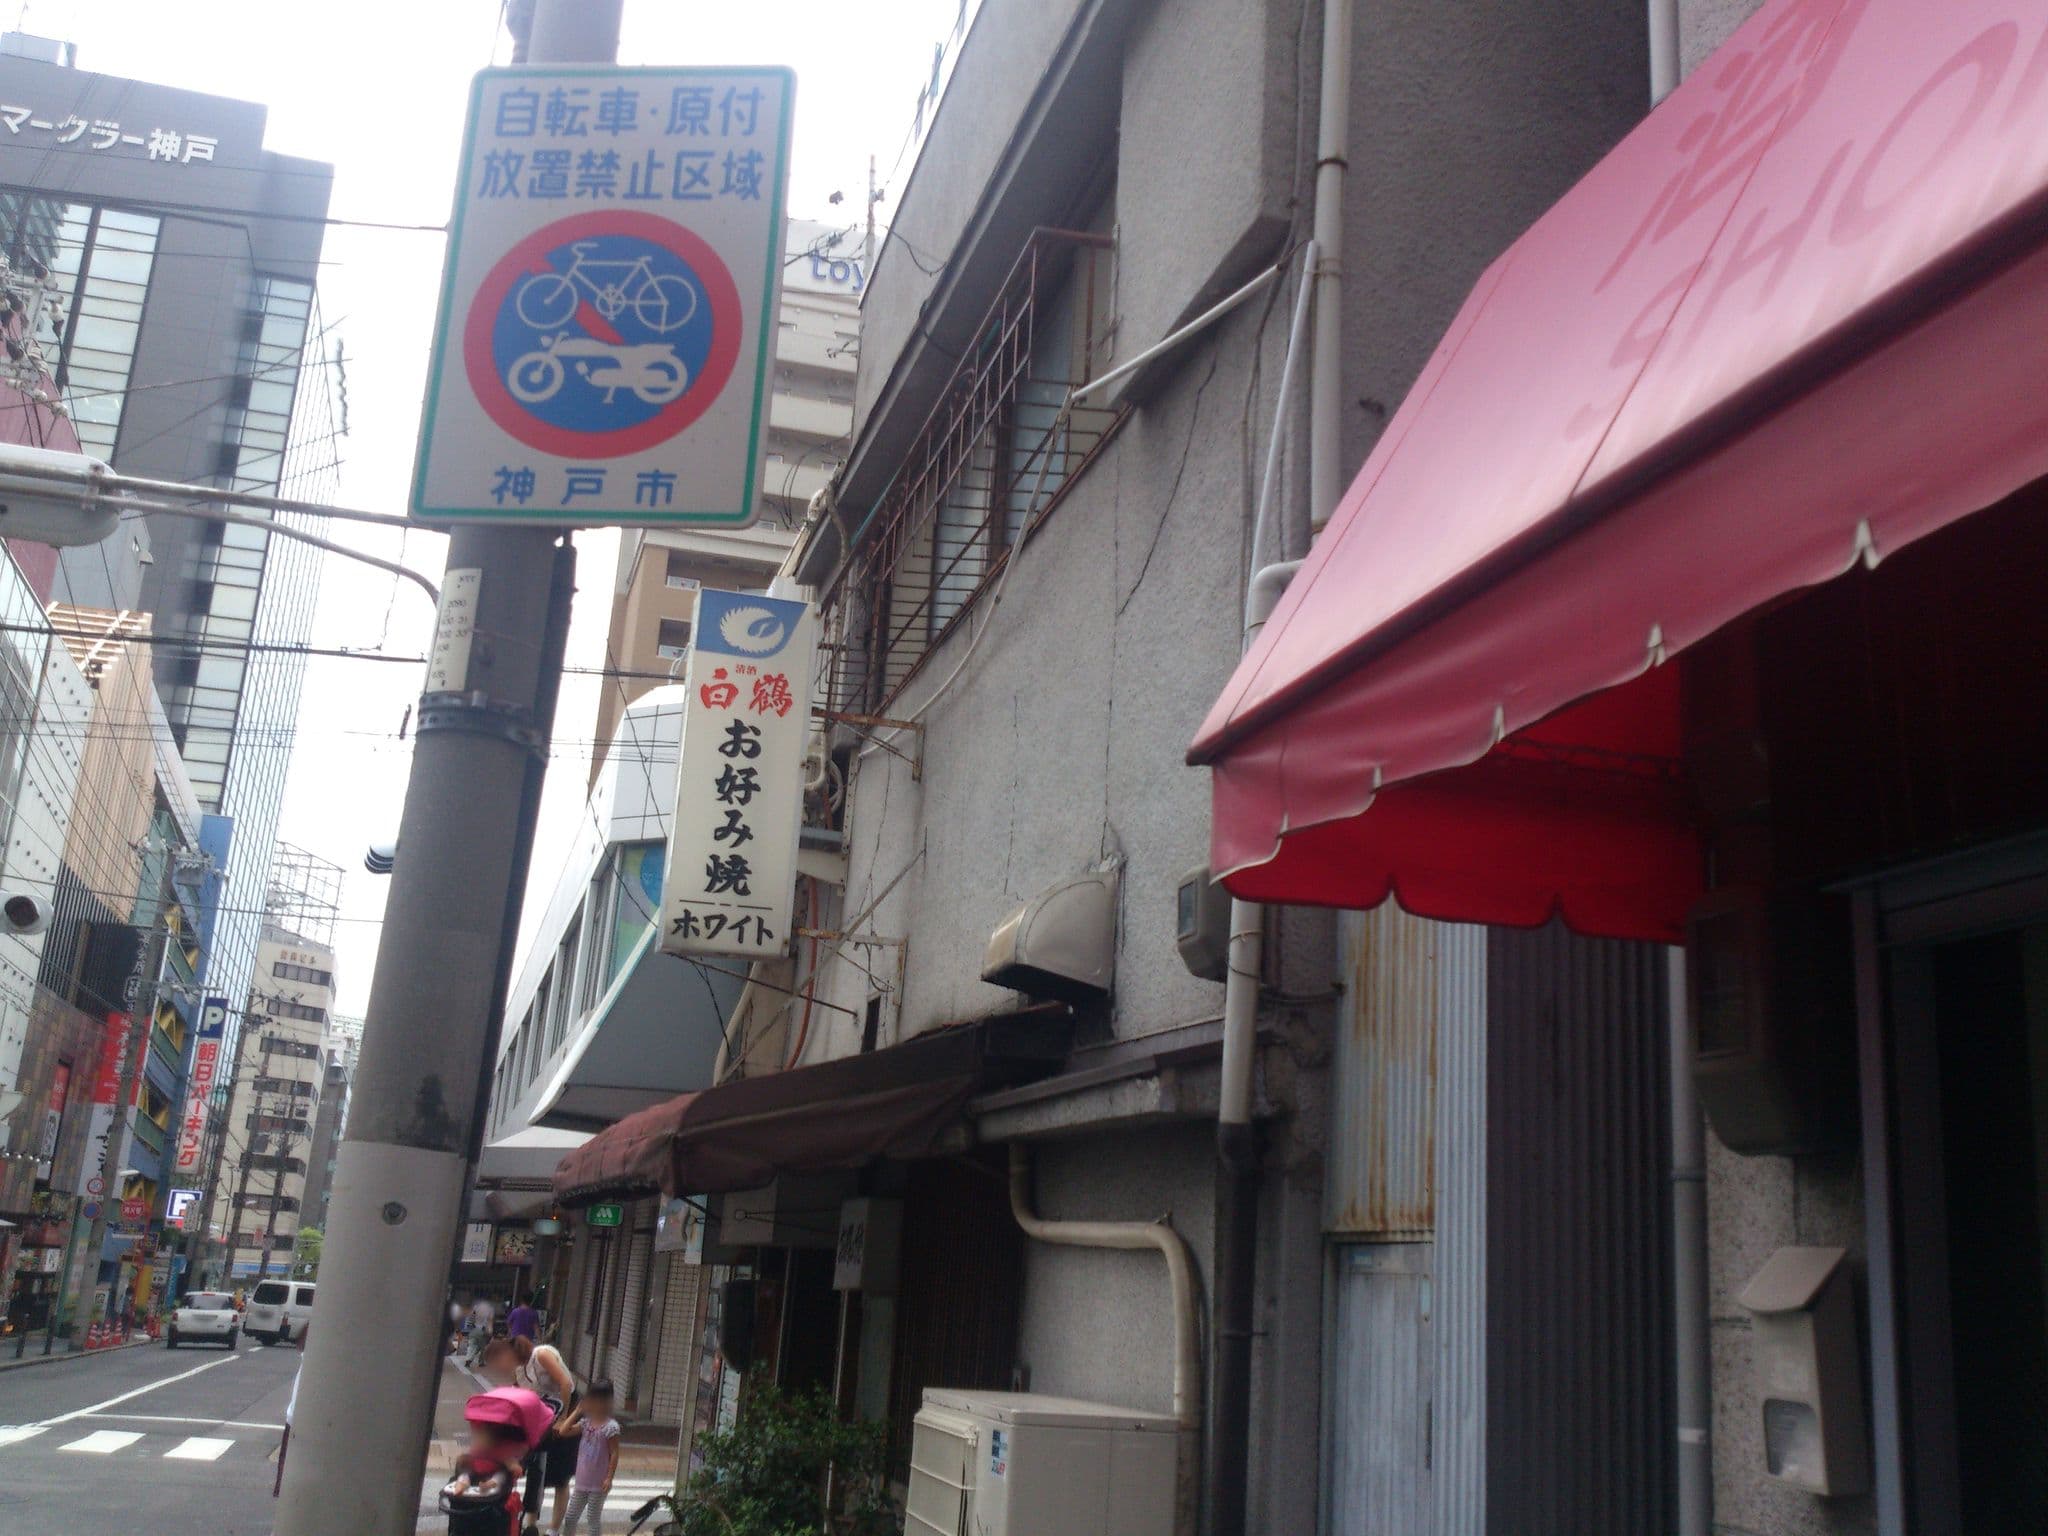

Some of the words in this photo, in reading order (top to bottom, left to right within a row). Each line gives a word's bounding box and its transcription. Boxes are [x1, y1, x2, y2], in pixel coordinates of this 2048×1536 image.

[1, 104, 219, 163] マークラー神戸
[494, 85, 764, 137] 自転車・原付
[478, 148, 764, 200] 放置禁止区域
[490, 465, 677, 507] 神戸市
[700, 667, 793, 718] 白鶴
[704, 718, 762, 897] お好み焼
[671, 908, 774, 946] ホワイト
[203, 1006, 224, 1031] P
[178, 1042, 218, 1167] 朝日パーキング
